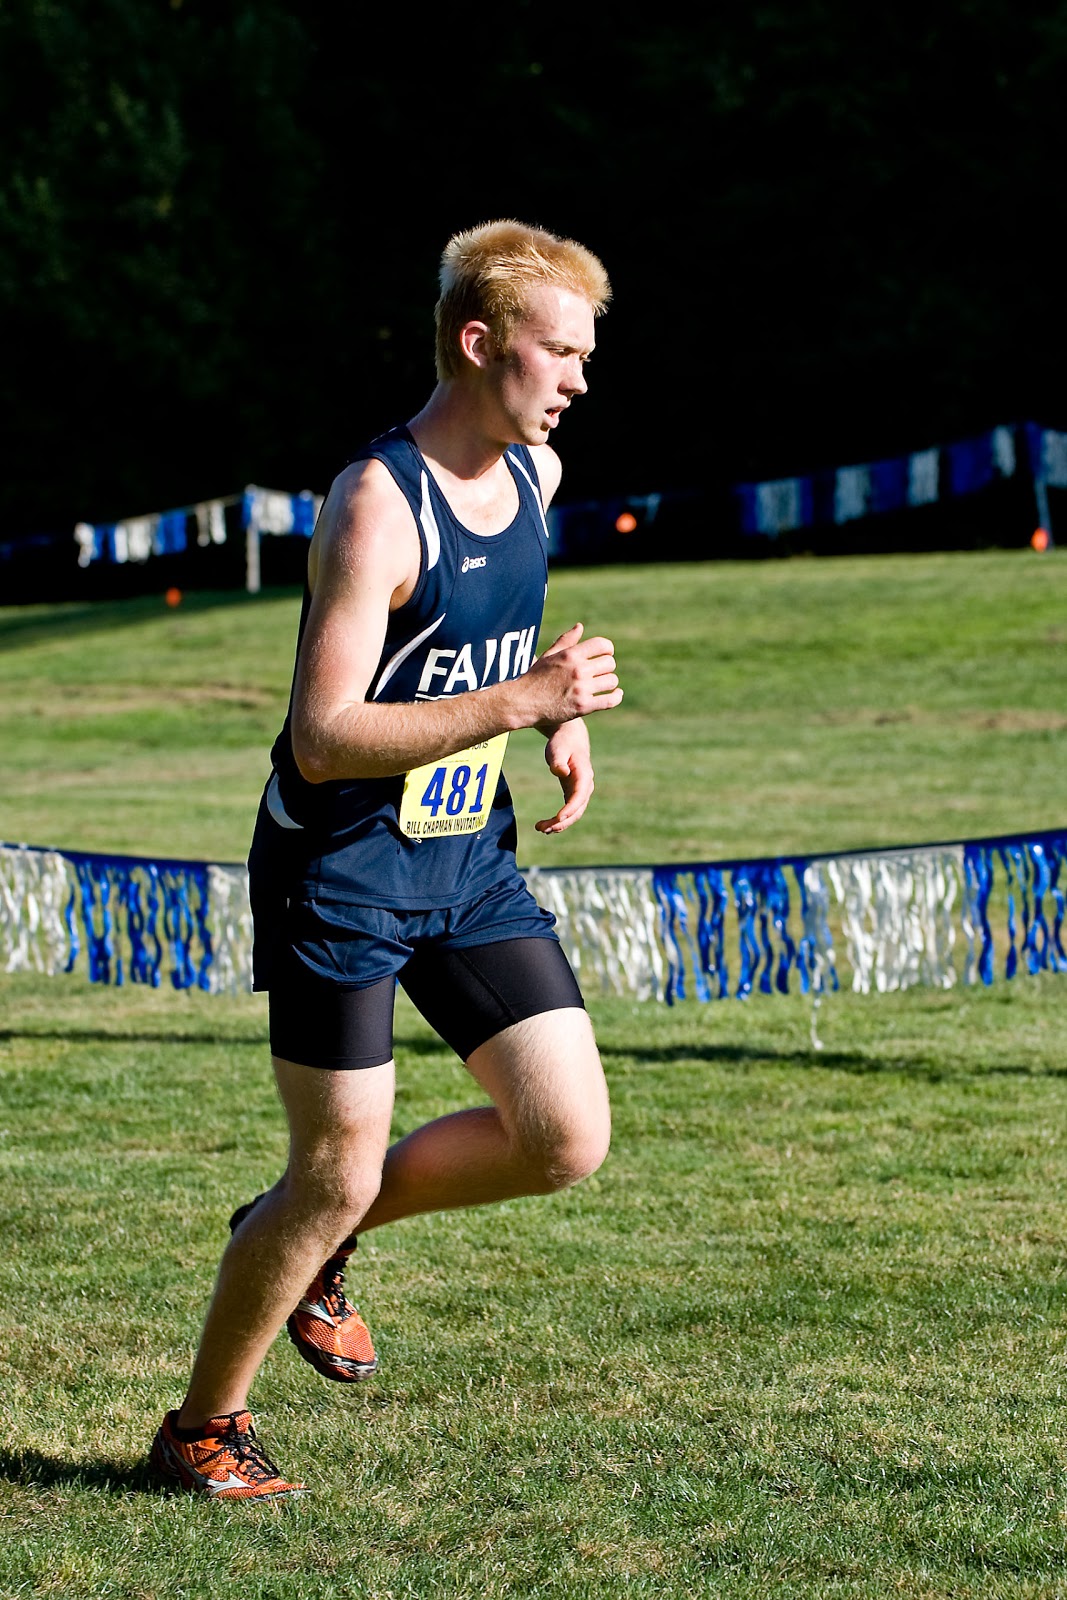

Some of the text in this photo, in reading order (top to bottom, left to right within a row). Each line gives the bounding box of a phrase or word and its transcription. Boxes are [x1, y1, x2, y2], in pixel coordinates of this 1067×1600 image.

[461, 556, 487, 573] asics
[417, 625, 536, 692] FAITH
[421, 763, 488, 817] 481
[406, 821, 420, 834] BILL
[422, 819, 453, 834] CHAPMAN
